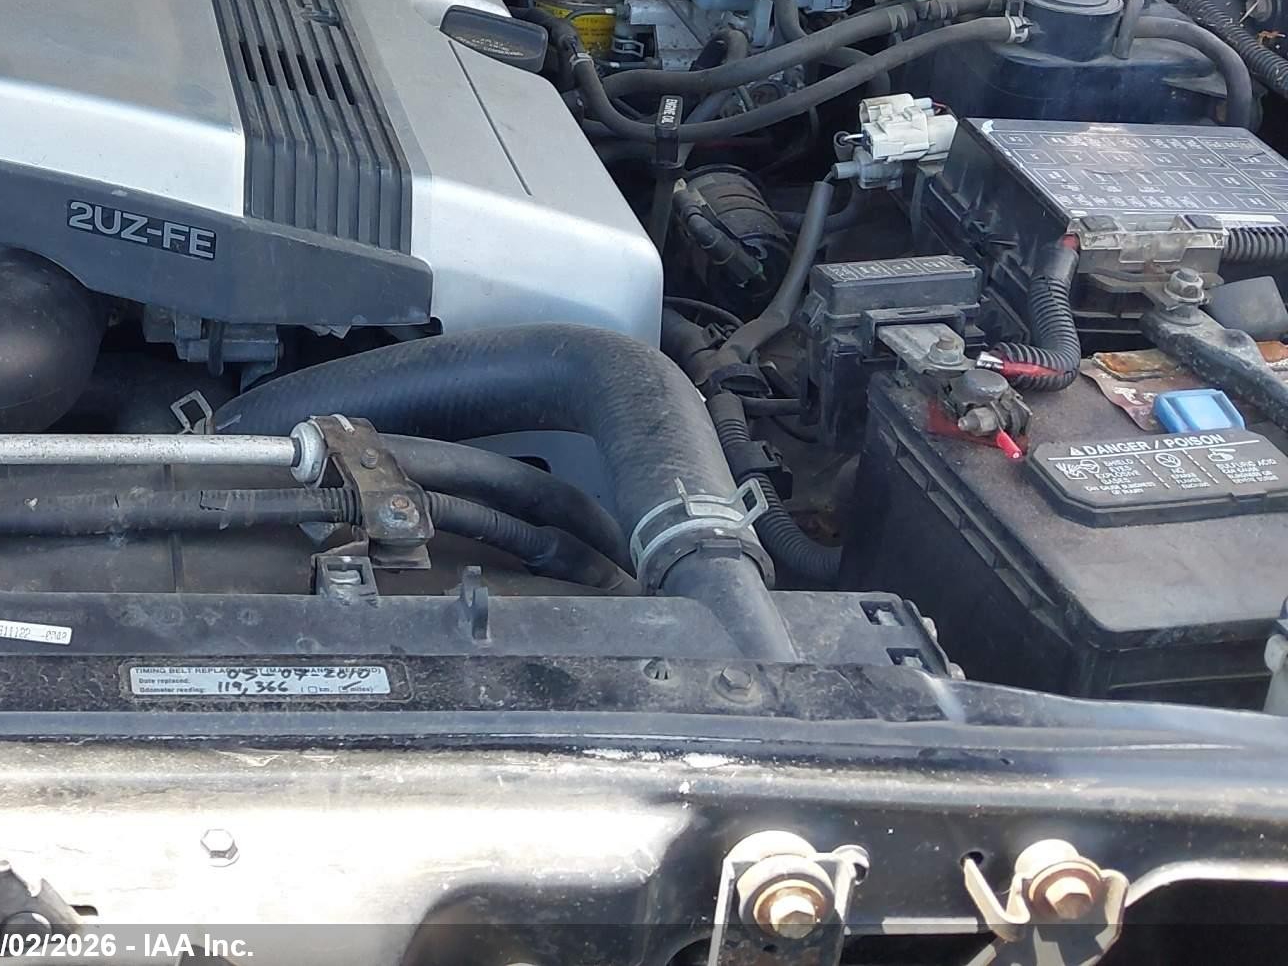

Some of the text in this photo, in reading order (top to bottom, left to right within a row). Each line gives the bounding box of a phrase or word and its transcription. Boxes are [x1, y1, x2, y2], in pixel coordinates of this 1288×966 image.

[661, 98, 678, 124] ENGINE OIL
[69, 201, 216, 259] 2UZ-FE
[1083, 441, 1152, 455] DANGER
[1164, 434, 1226, 448] POISON
[1103, 458, 1134, 467] SHIELD
